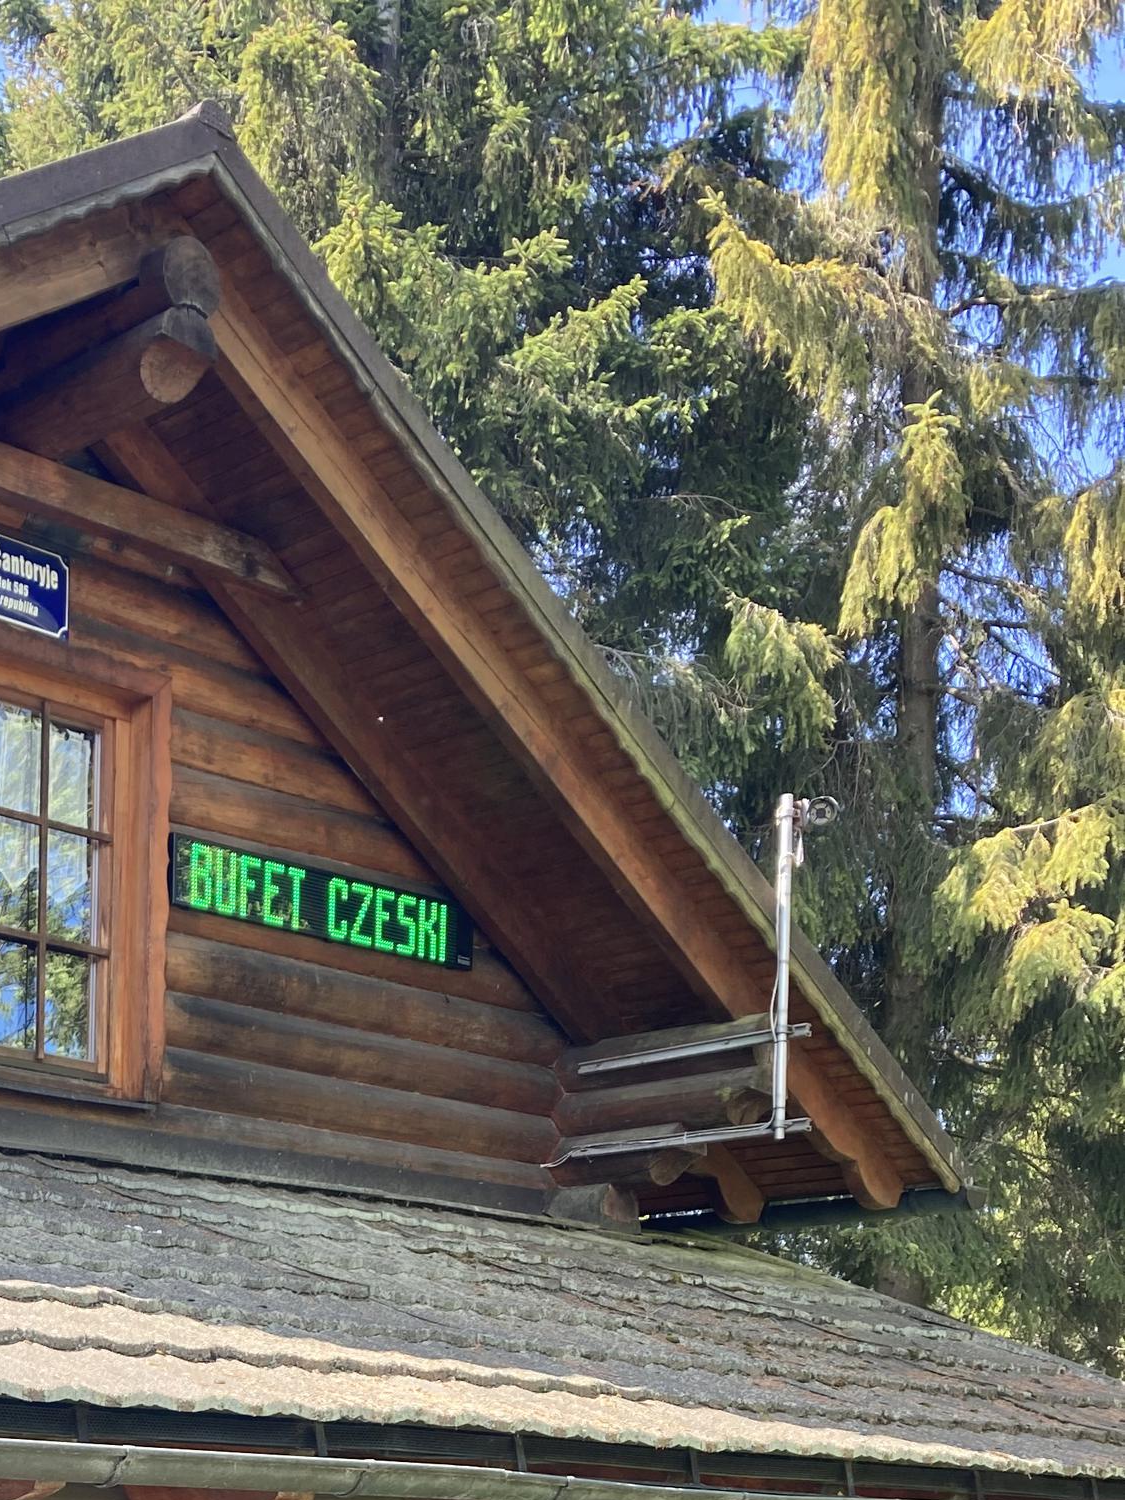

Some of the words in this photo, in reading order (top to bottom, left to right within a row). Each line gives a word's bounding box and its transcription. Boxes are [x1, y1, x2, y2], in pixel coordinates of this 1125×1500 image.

[0, 593, 39, 617] republika
[189, 842, 306, 931] BUFET
[328, 877, 448, 962] CZESKI
